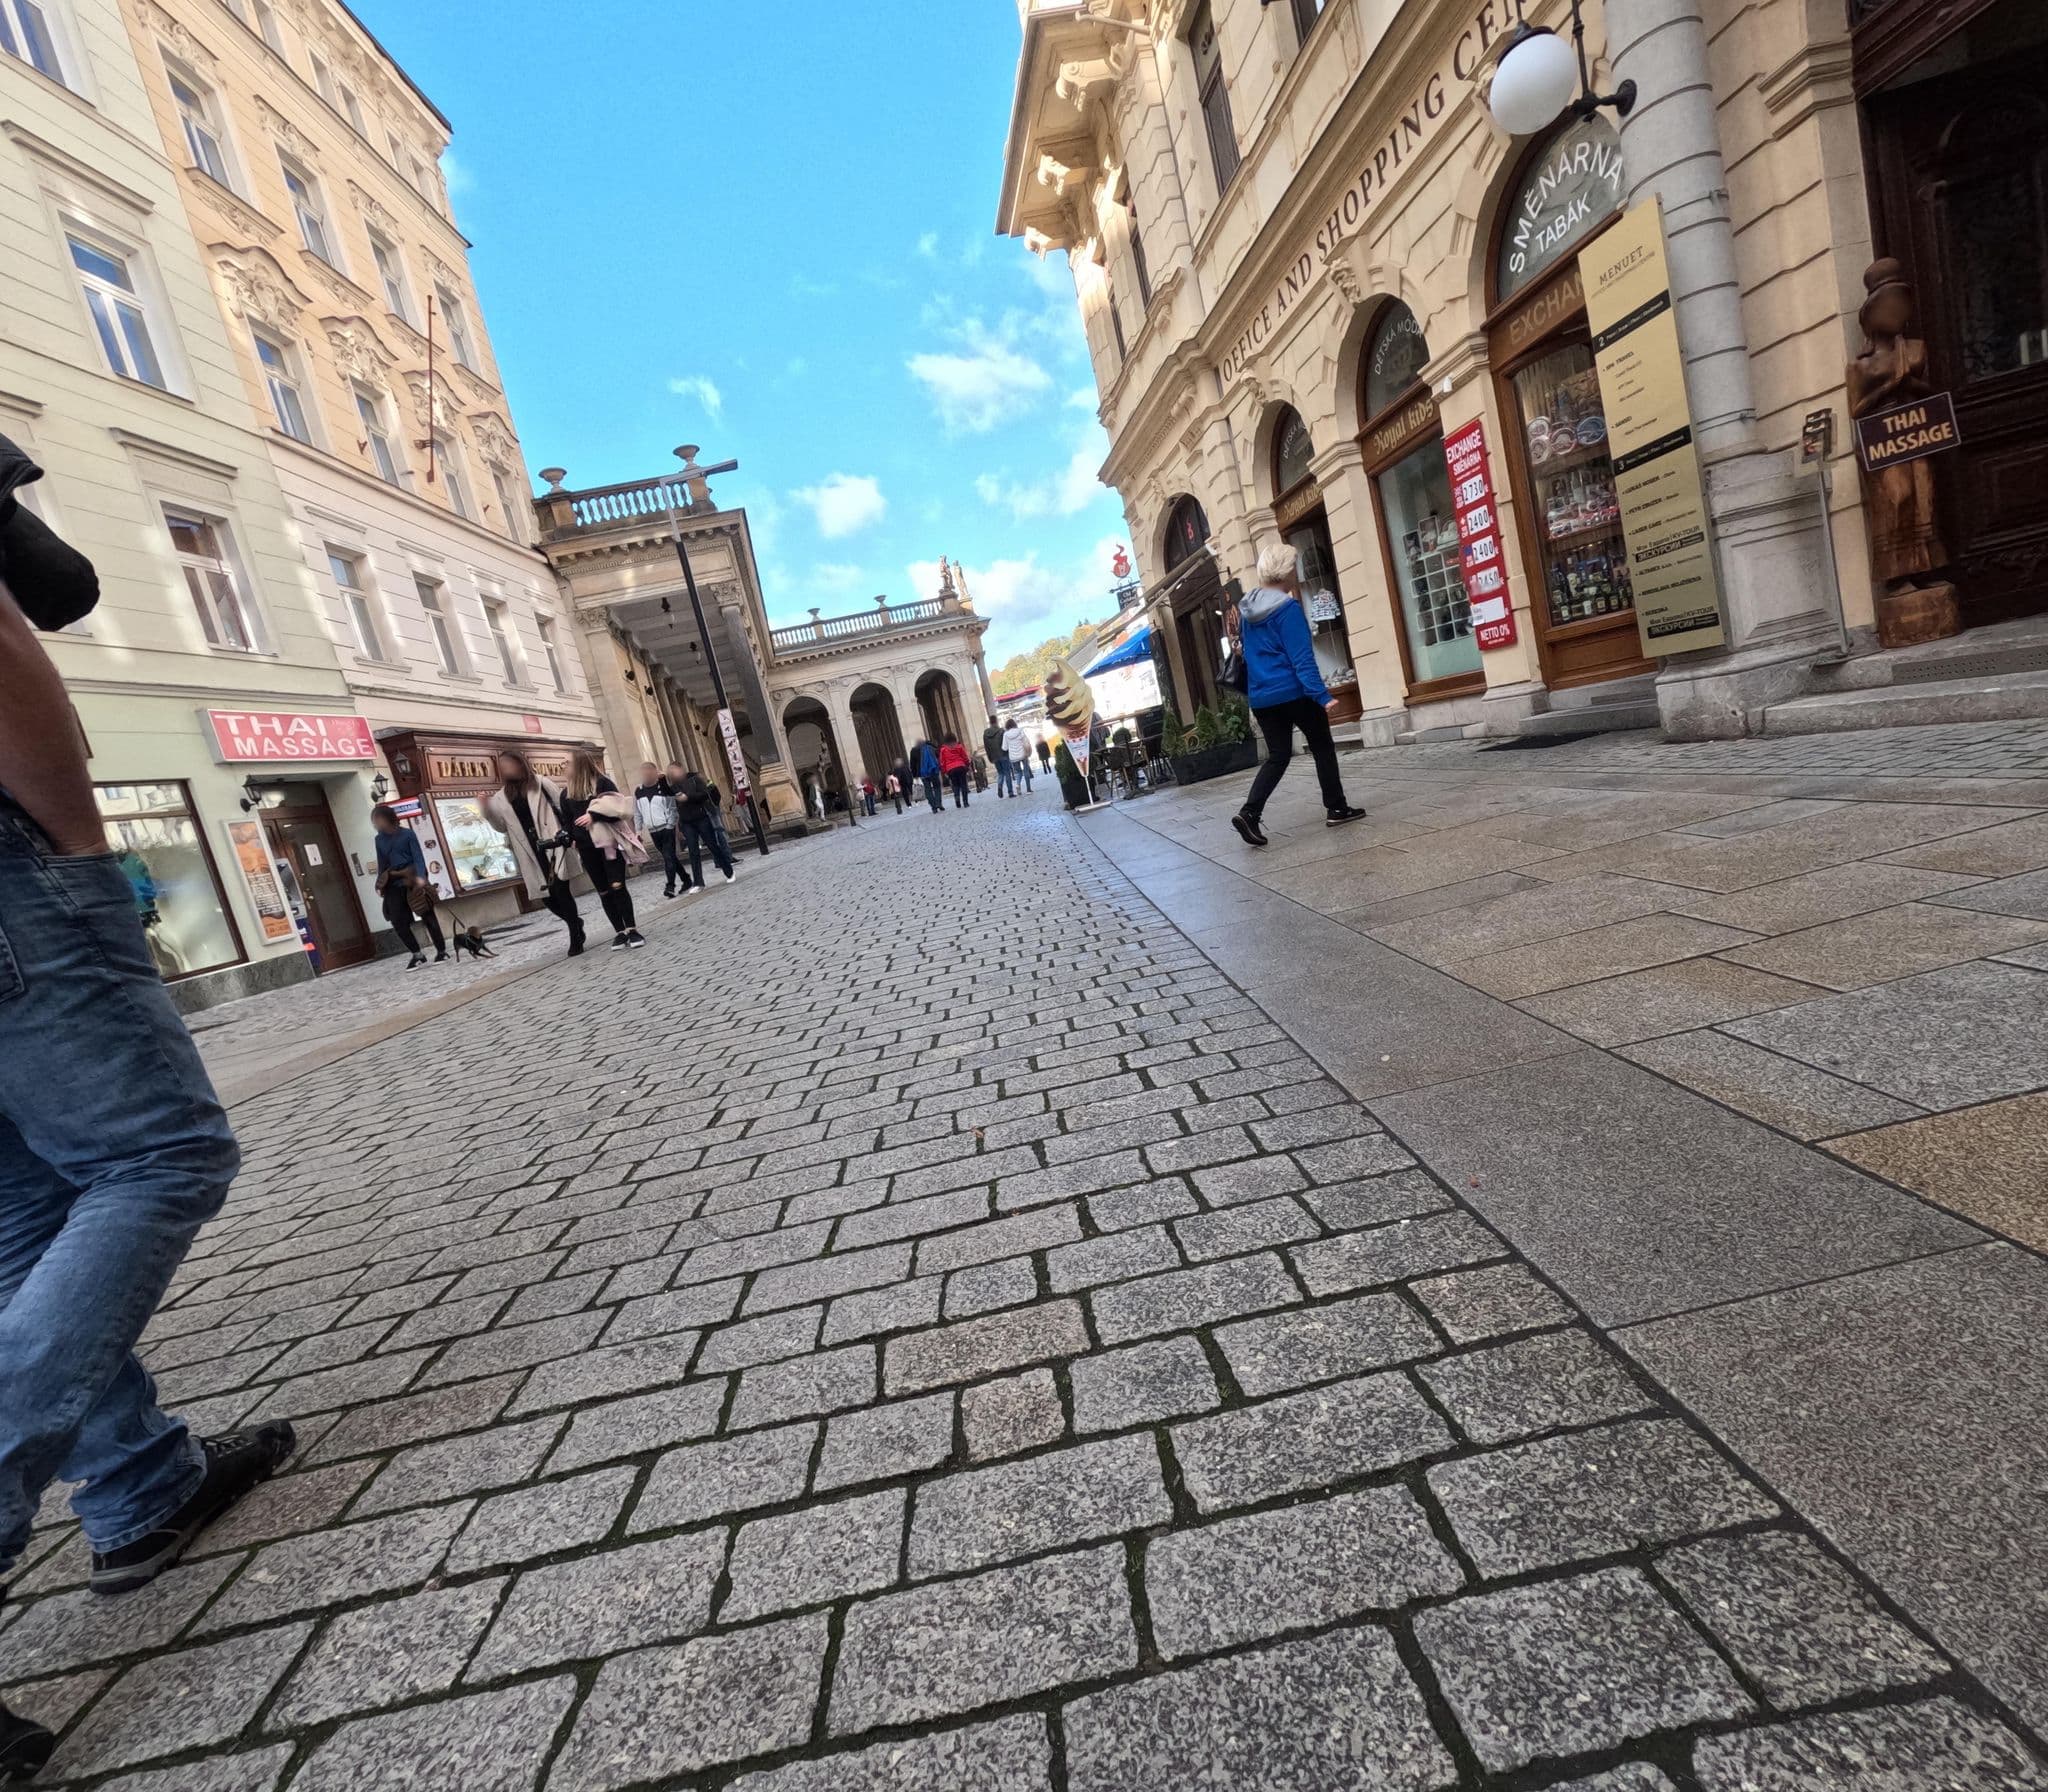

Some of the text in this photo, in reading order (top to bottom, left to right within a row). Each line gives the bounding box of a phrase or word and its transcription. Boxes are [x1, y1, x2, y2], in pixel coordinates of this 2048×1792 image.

[1509, 141, 1624, 273] SMĚNÁRNA
[1223, 301, 1272, 382] OFFICE
[1277, 251, 1312, 318] AND
[1315, 73, 1446, 263] SHOPPING
[1536, 192, 1592, 253] TABÁK
[1599, 245, 1644, 286] MENUET
[1598, 336, 1606, 347] 2
[1883, 407, 1926, 434] THAI
[1446, 429, 1483, 464] EXCHANGE
[1868, 423, 1953, 461] MASSAGE
[1463, 479, 1484, 501] 2730
[1468, 509, 1489, 531] 2400
[1473, 540, 1494, 561] 2400
[1480, 626, 1500, 641] NETTO
[214, 714, 327, 737] THAI
[233, 737, 373, 757] MASSAGE
[437, 756, 491, 777] DÁRKY
